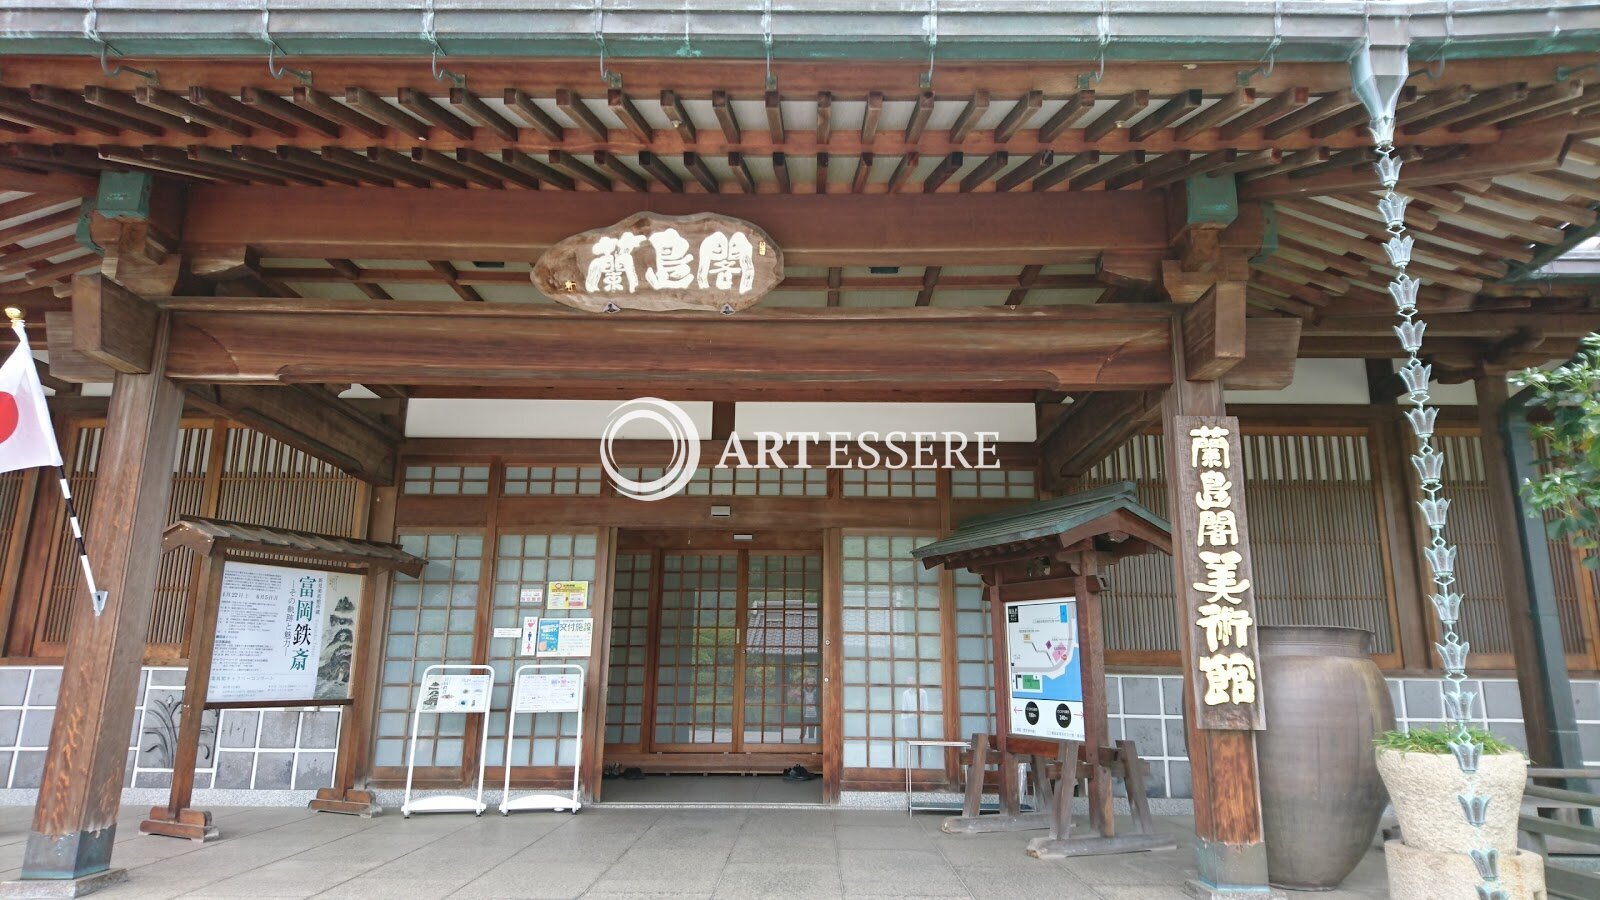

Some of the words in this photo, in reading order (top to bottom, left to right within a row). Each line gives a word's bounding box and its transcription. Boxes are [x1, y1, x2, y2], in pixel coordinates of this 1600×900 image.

[585, 228, 755, 294] 蘭島閣
[1189, 425, 1256, 706] 蘭島閣美術館
[289, 575, 316, 671] 富岡鉄斎
